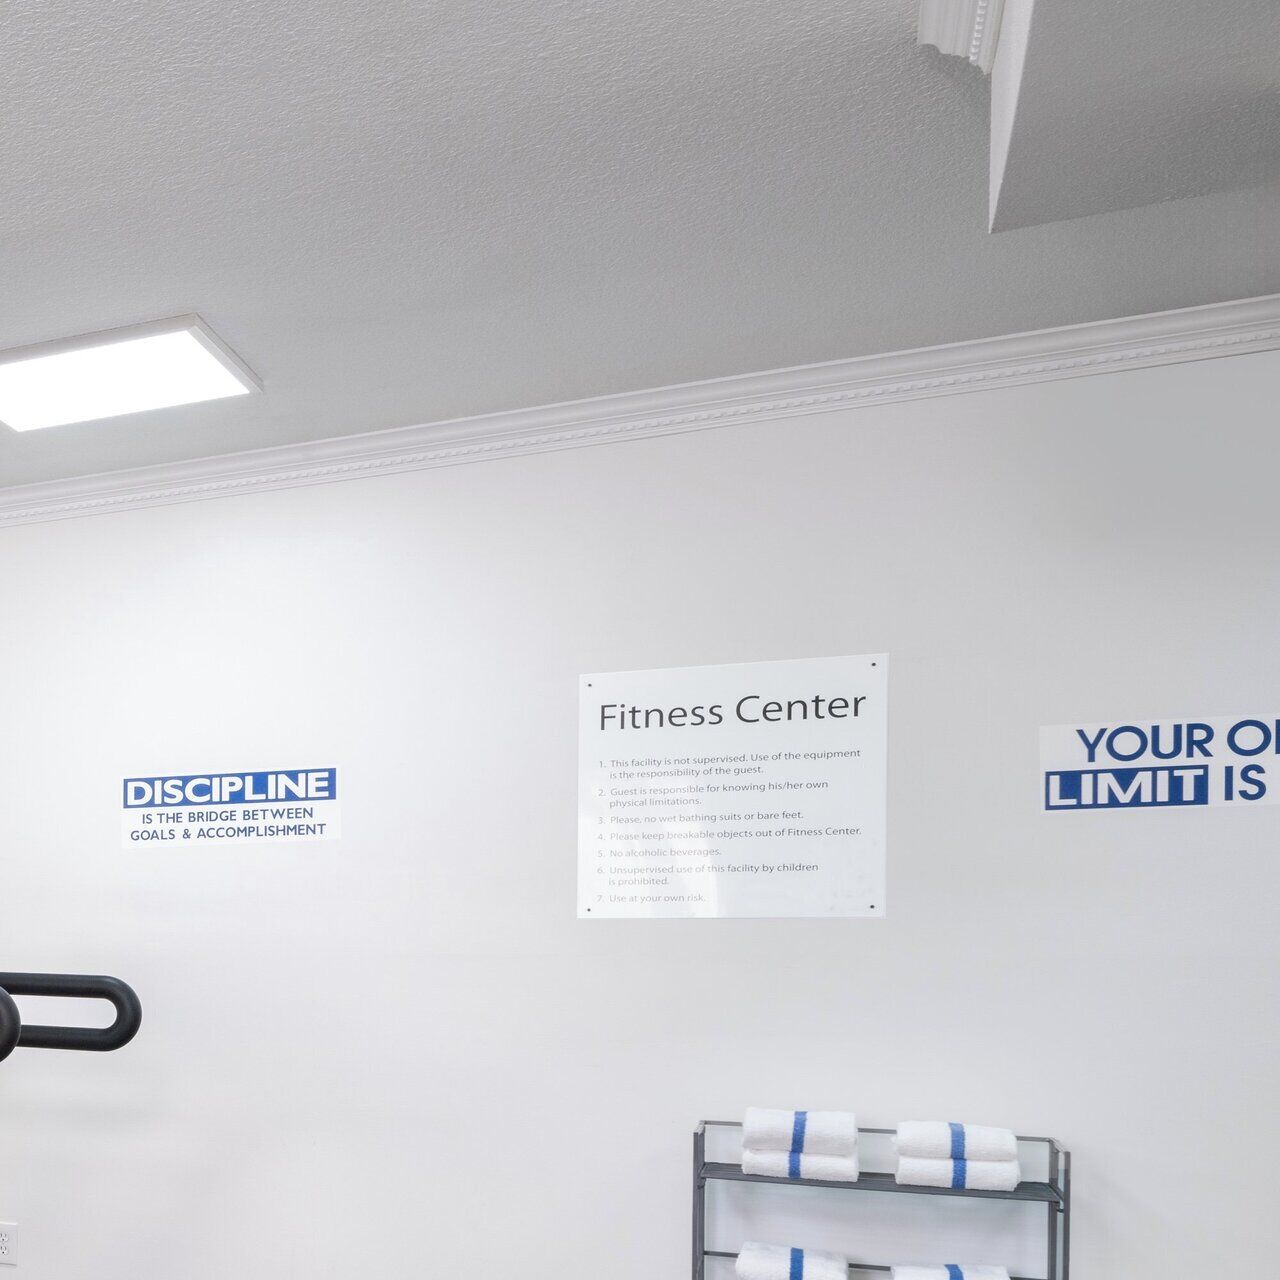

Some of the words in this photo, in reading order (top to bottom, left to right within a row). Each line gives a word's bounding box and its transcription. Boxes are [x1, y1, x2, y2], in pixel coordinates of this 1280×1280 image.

[600, 703, 724, 731] Fitness
[735, 694, 867, 723] Center
[1076, 722, 1215, 763] YOUR
[610, 759, 629, 767] This
[631, 758, 662, 768] facility
[692, 754, 748, 765] supervised.
[750, 753, 769, 761] Use
[771, 752, 782, 760] of
[784, 752, 801, 760] the
[803, 750, 861, 760] equipment
[636, 768, 700, 779] responsibility
[702, 767, 713, 775] of
[715, 766, 731, 775] the
[733, 766, 764, 776] guest.
[126, 771, 330, 806] DISCIPLINE
[610, 788, 637, 796] Guest
[639, 787, 647, 795] is
[650, 785, 704, 796] responsible
[706, 784, 719, 792] for
[722, 783, 766, 793] knowing
[768, 781, 804, 790] his/her
[806, 781, 828, 789] own
[1048, 768, 1204, 806] LIMIT
[1224, 764, 1267, 801] IS
[609, 798, 647, 808] physical
[649, 798, 702, 806] limitations.
[142, 813, 153, 824] IS
[156, 812, 183, 824] THE
[188, 810, 237, 823] BRIDGE
[242, 807, 314, 821] BETWEEN
[680, 813, 717, 823] bathing
[719, 813, 741, 821] suits
[757, 812, 780, 820] bare
[782, 811, 804, 819] feet.
[130, 829, 176, 841] GOALS
[182, 828, 191, 839] &
[196, 823, 327, 839] ACCOMPLISHMENT
[610, 832, 640, 840] Please
[642, 832, 665, 841] keep
[667, 830, 715, 840] breakable
[717, 830, 753, 839] objects
[755, 829, 772, 838] out
[775, 828, 785, 836] of
[787, 828, 823, 836] Fitness
[825, 827, 861, 836] Center.
[610, 849, 623, 857] No
[625, 848, 667, 857] alcoholic
[610, 865, 674, 875] Unsupervised
[676, 866, 691, 874] use
[695, 864, 705, 873] of
[708, 864, 725, 872] this
[727, 863, 760, 874] facility
[762, 863, 775, 873] by
[777, 863, 819, 872] children
[610, 894, 626, 902] Use
[640, 895, 662, 904] your
[664, 894, 685, 902] own
